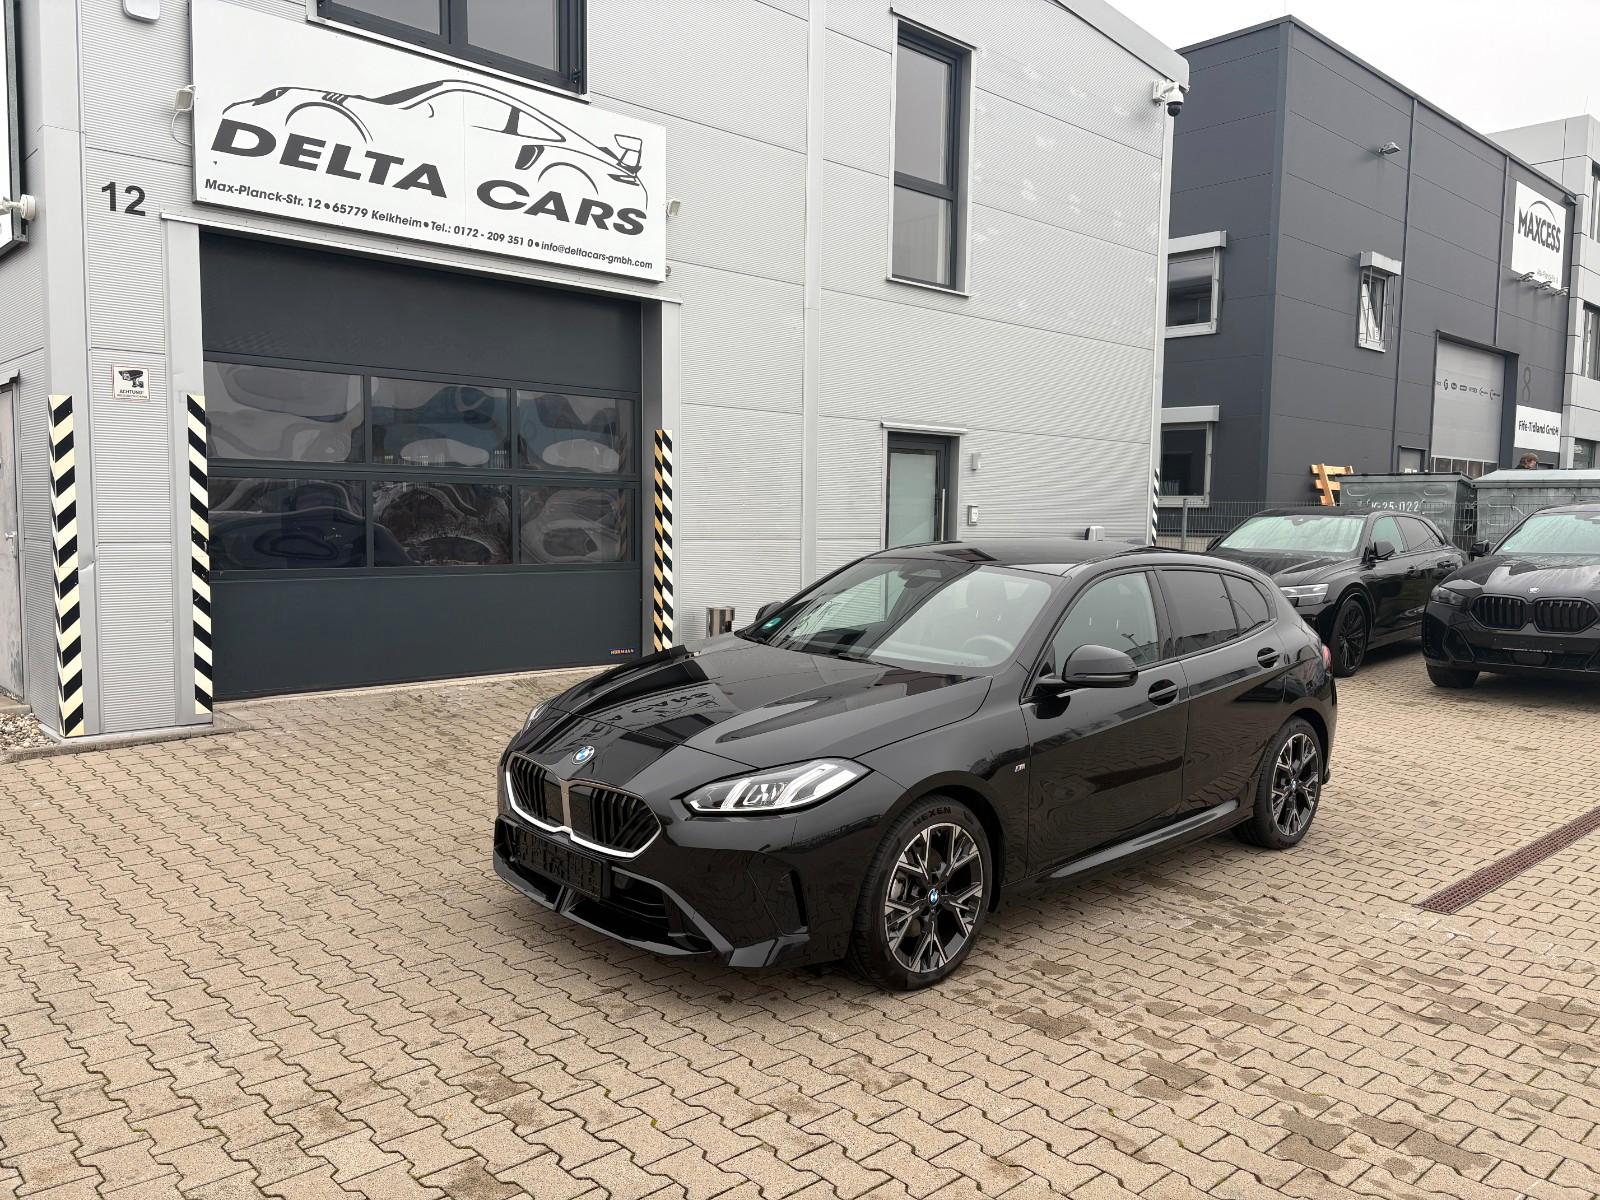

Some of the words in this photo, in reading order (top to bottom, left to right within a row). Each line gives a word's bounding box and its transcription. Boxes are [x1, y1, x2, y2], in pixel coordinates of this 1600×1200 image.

[101, 181, 146, 217] 12
[211, 118, 447, 198] DELTA
[476, 180, 647, 235] CARS
[204, 178, 304, 206] Max-Planck-Str.
[308, 198, 321, 209] 12
[332, 203, 368, 217] 65779
[371, 210, 422, 228] Kelkheim
[431, 221, 451, 233] Tel.:
[454, 226, 478, 238] 0172
[487, 231, 505, 242] 209
[507, 234, 524, 246] 351
[541, 241, 653, 269] info@deltacars-gmbh.com
[1518, 206, 1561, 253] MAXCESS
[912, 806, 952, 827] NEXEN
